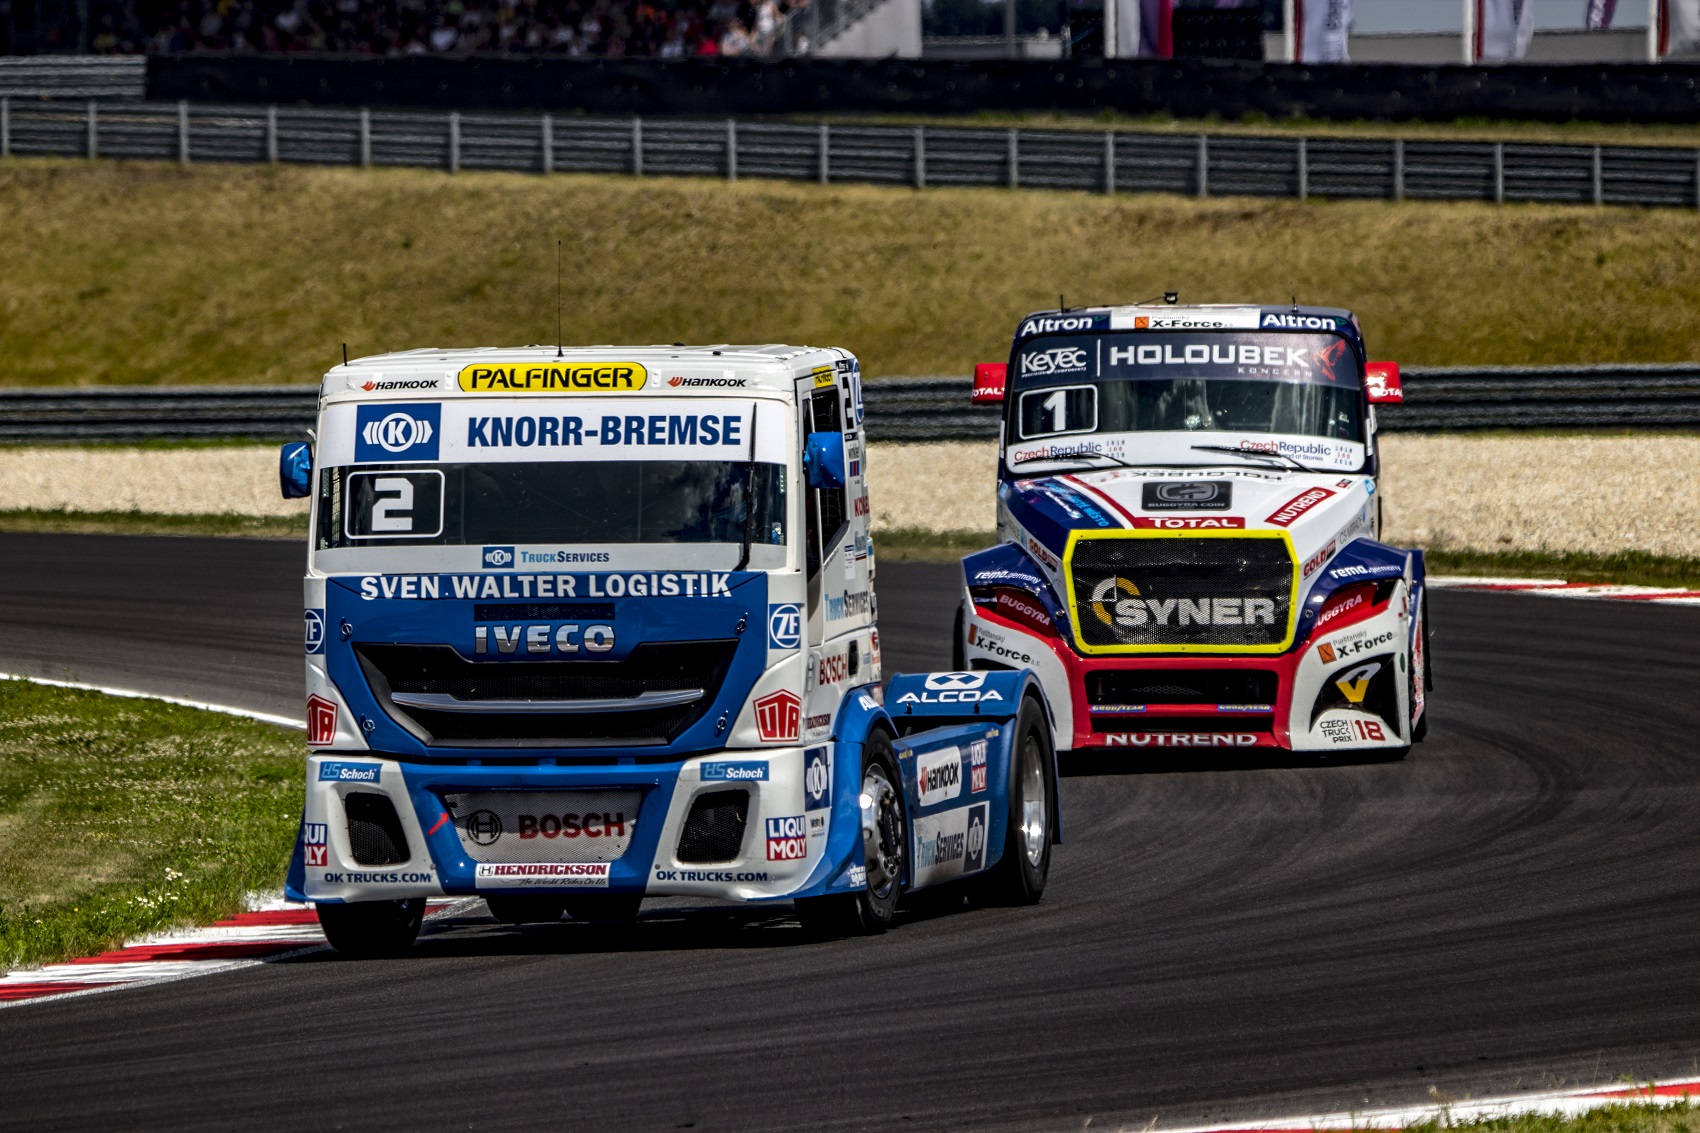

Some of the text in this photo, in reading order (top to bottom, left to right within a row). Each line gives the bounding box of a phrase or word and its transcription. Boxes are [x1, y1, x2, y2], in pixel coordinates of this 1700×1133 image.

[1020, 316, 1093, 337] Altron
[1151, 319, 1224, 329] X-Force
[1262, 313, 1336, 332] Altron
[1021, 346, 1087, 376] KeyTec
[1109, 343, 1311, 368] HOLOUBEK
[471, 367, 634, 389] PALFINGER
[1237, 366, 1312, 378] KONCERN
[971, 387, 1003, 398] OTAL
[1042, 390, 1067, 432] 1
[467, 415, 743, 448] KNORR-BREMSE
[1302, 454, 1324, 462] Stories
[371, 477, 414, 532] 2
[1147, 501, 1199, 509] BUGGYRA
[1273, 489, 1328, 523] NUTREND
[1147, 516, 1238, 529] TOTAL
[1303, 551, 1326, 578] GOLD
[360, 573, 733, 601] SVEN WALTER LOGISTIK
[999, 594, 1051, 626] BUGGYRA
[1114, 597, 1277, 627] SYNER
[773, 613, 800, 639] ZF
[474, 624, 616, 655] IVECO
[975, 636, 1031, 664] X-Force
[1337, 630, 1393, 659] X-Force
[819, 653, 848, 687] BOSCH
[895, 689, 1005, 704] ALCOA
[757, 695, 800, 739] UTA
[1091, 704, 1146, 713] GOODYEAR
[1218, 704, 1272, 712] GOODYEAR
[1319, 719, 1349, 730] CZECH
[1321, 727, 1350, 737] TRUCK
[1354, 719, 1386, 742] 18
[1104, 733, 1259, 747] NUTREND
[1332, 733, 1354, 744] PRIX
[339, 767, 376, 781] Schoch
[725, 766, 764, 779] Schoch
[517, 812, 626, 841] BOSCH
[768, 817, 806, 839] LIQUI
[769, 838, 808, 859] MOLY
[324, 872, 432, 884] OK TRUCKS.COM
[493, 864, 608, 876] HENDRICKSON
[656, 870, 768, 882] OK TRUCKS.COM
[584, 878, 595, 886] On
